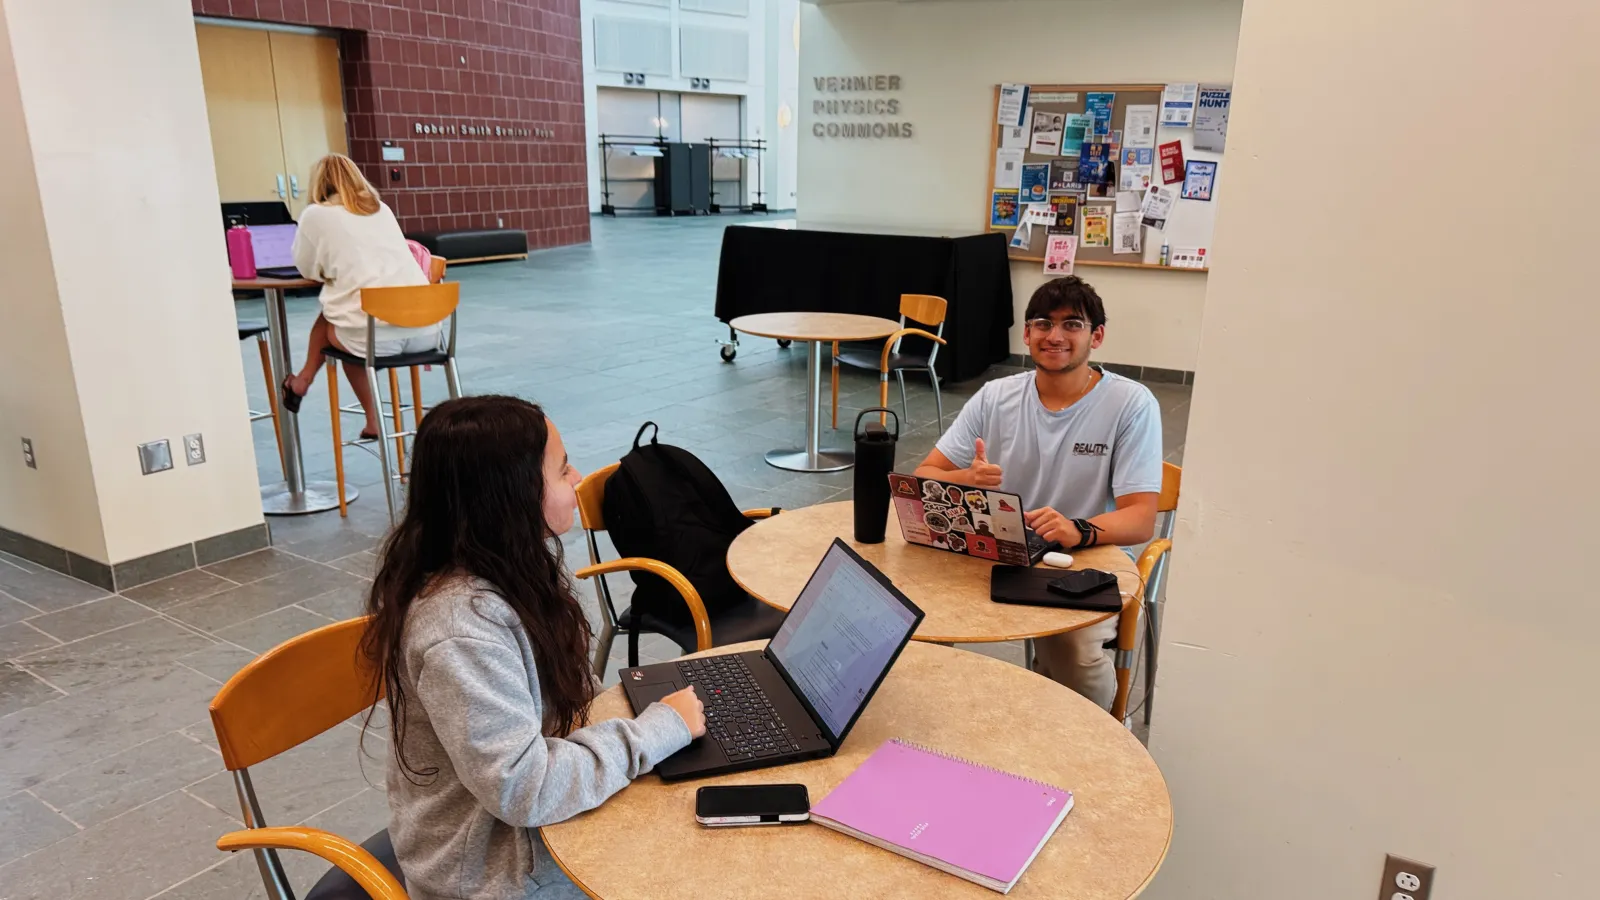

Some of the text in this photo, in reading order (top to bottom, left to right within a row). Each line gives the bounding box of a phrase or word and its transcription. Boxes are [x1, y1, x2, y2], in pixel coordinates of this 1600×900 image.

[812, 75, 901, 92] VERNIER
[1200, 91, 1231, 99] PUZZLE
[812, 99, 899, 115] PHYSICS
[1199, 99, 1230, 108] HUNT
[414, 122, 455, 135] Robert
[461, 124, 491, 136] Smith
[496, 125, 531, 137] Seminar
[812, 122, 913, 138] COMMONS
